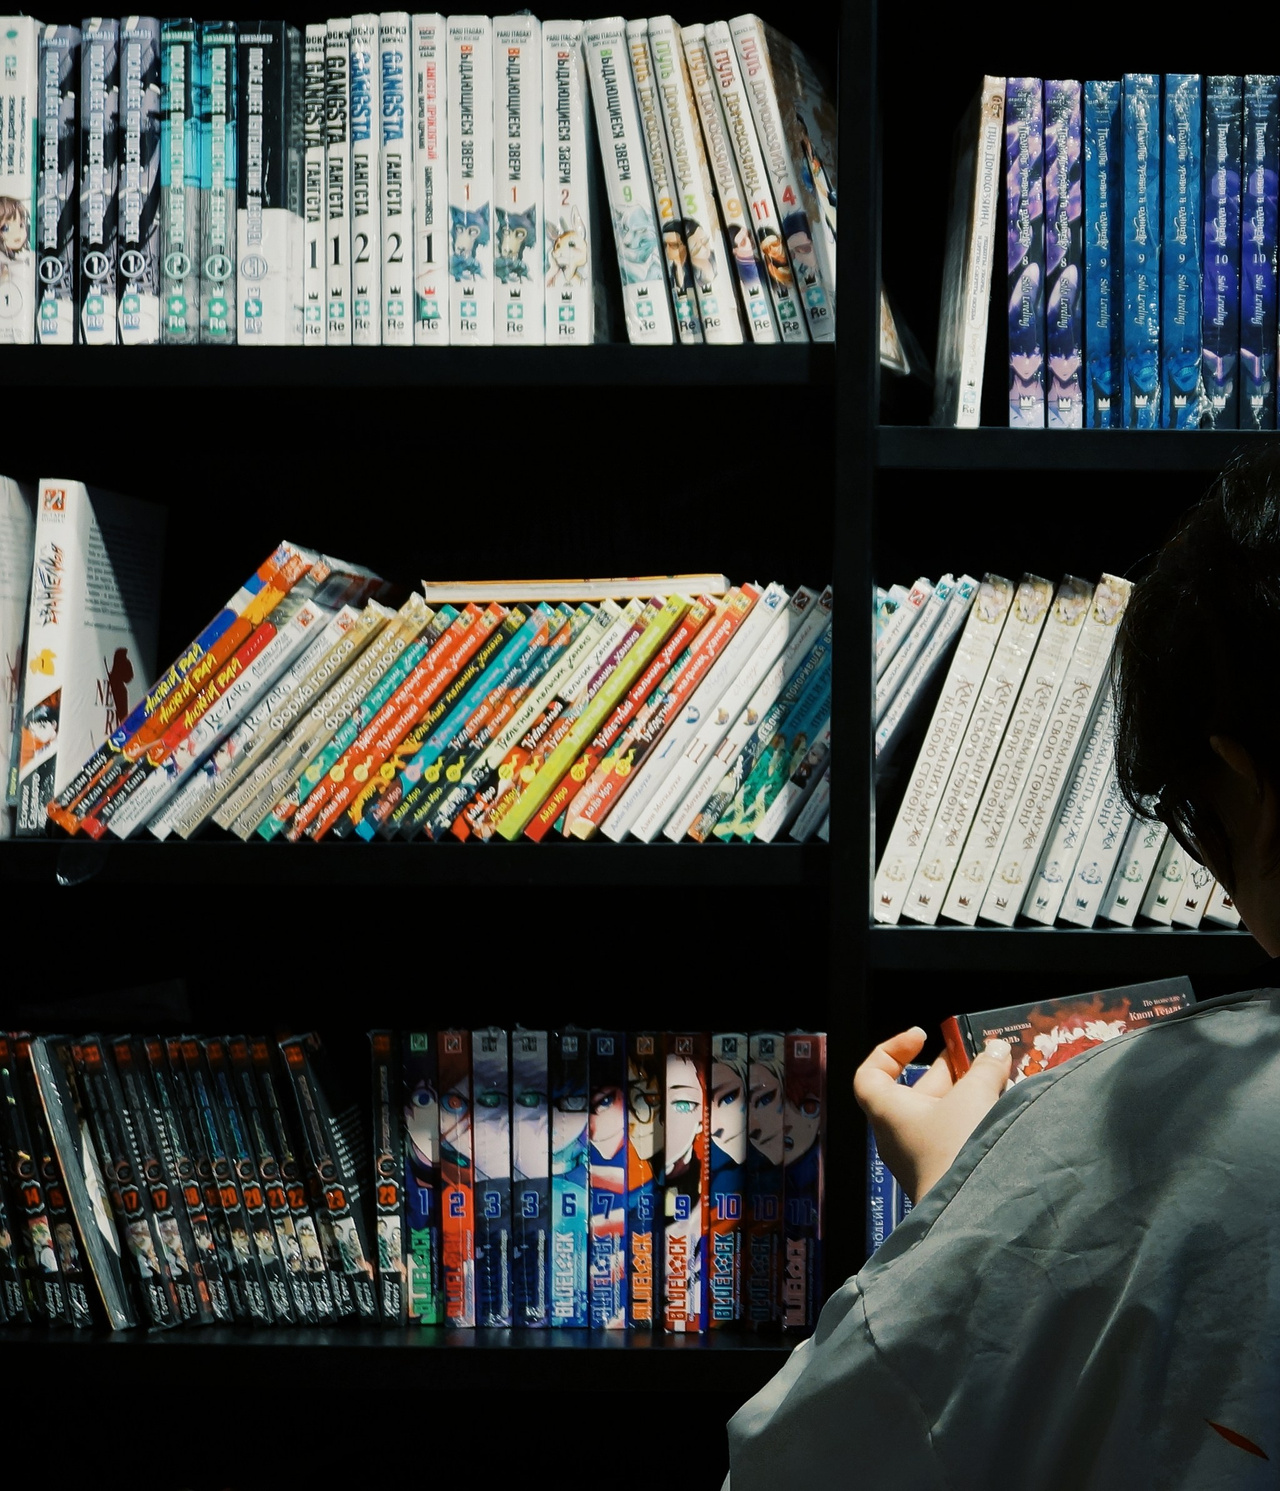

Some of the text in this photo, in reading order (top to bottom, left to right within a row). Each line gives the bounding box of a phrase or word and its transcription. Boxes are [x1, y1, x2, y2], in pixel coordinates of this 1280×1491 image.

[461, 45, 475, 180] ВЫДАЮЩИЕСЯ ЗВЕРИ
[508, 48, 521, 182] ВЫДАЮЩИЕСЯ ЗВЕРИ
[558, 52, 572, 185] ВЫДАЮЩИЕСЯ ЗВЕРИ
[601, 50, 632, 181] ВЫДАЮЩИЕСЯ ЗВЕРИ
[307, 161, 322, 223] ГАНГСТА
[330, 157, 345, 219] ГАНГСТА
[355, 154, 370, 217] ГАНГСТА
[387, 153, 403, 217] ГАНГСТА
[783, 185, 797, 206] 4
[660, 197, 673, 219] 2
[684, 194, 696, 215] 3
[727, 198, 741, 218] 9
[752, 199, 770, 220] 11
[310, 241, 319, 269] 1
[333, 236, 342, 266] 1
[355, 233, 371, 264] 2
[388, 233, 405, 264] 2
[424, 234, 434, 264] 1
[1215, 254, 1228, 263] 10
[1096, 278, 1110, 328] Solo Leveling
[1174, 275, 1188, 325] Solo Leveling
[1213, 275, 1228, 326] Solo Leveling
[924, 717, 948, 759] СВОЮ
[1041, 719, 1064, 761] СВОЮ
[902, 760, 932, 825] СТОРОНУ
[1019, 763, 1048, 828] СТОРОНУ
[417, 1188, 430, 1215] 1
[449, 1191, 465, 1218] 2
[484, 1191, 501, 1218] 3
[521, 1191, 539, 1218] 3
[561, 1192, 577, 1218] 6
[597, 1192, 615, 1219] 7
[637, 1194, 654, 1220] 8
[674, 1194, 691, 1220] 9
[714, 1192, 742, 1220] 10
